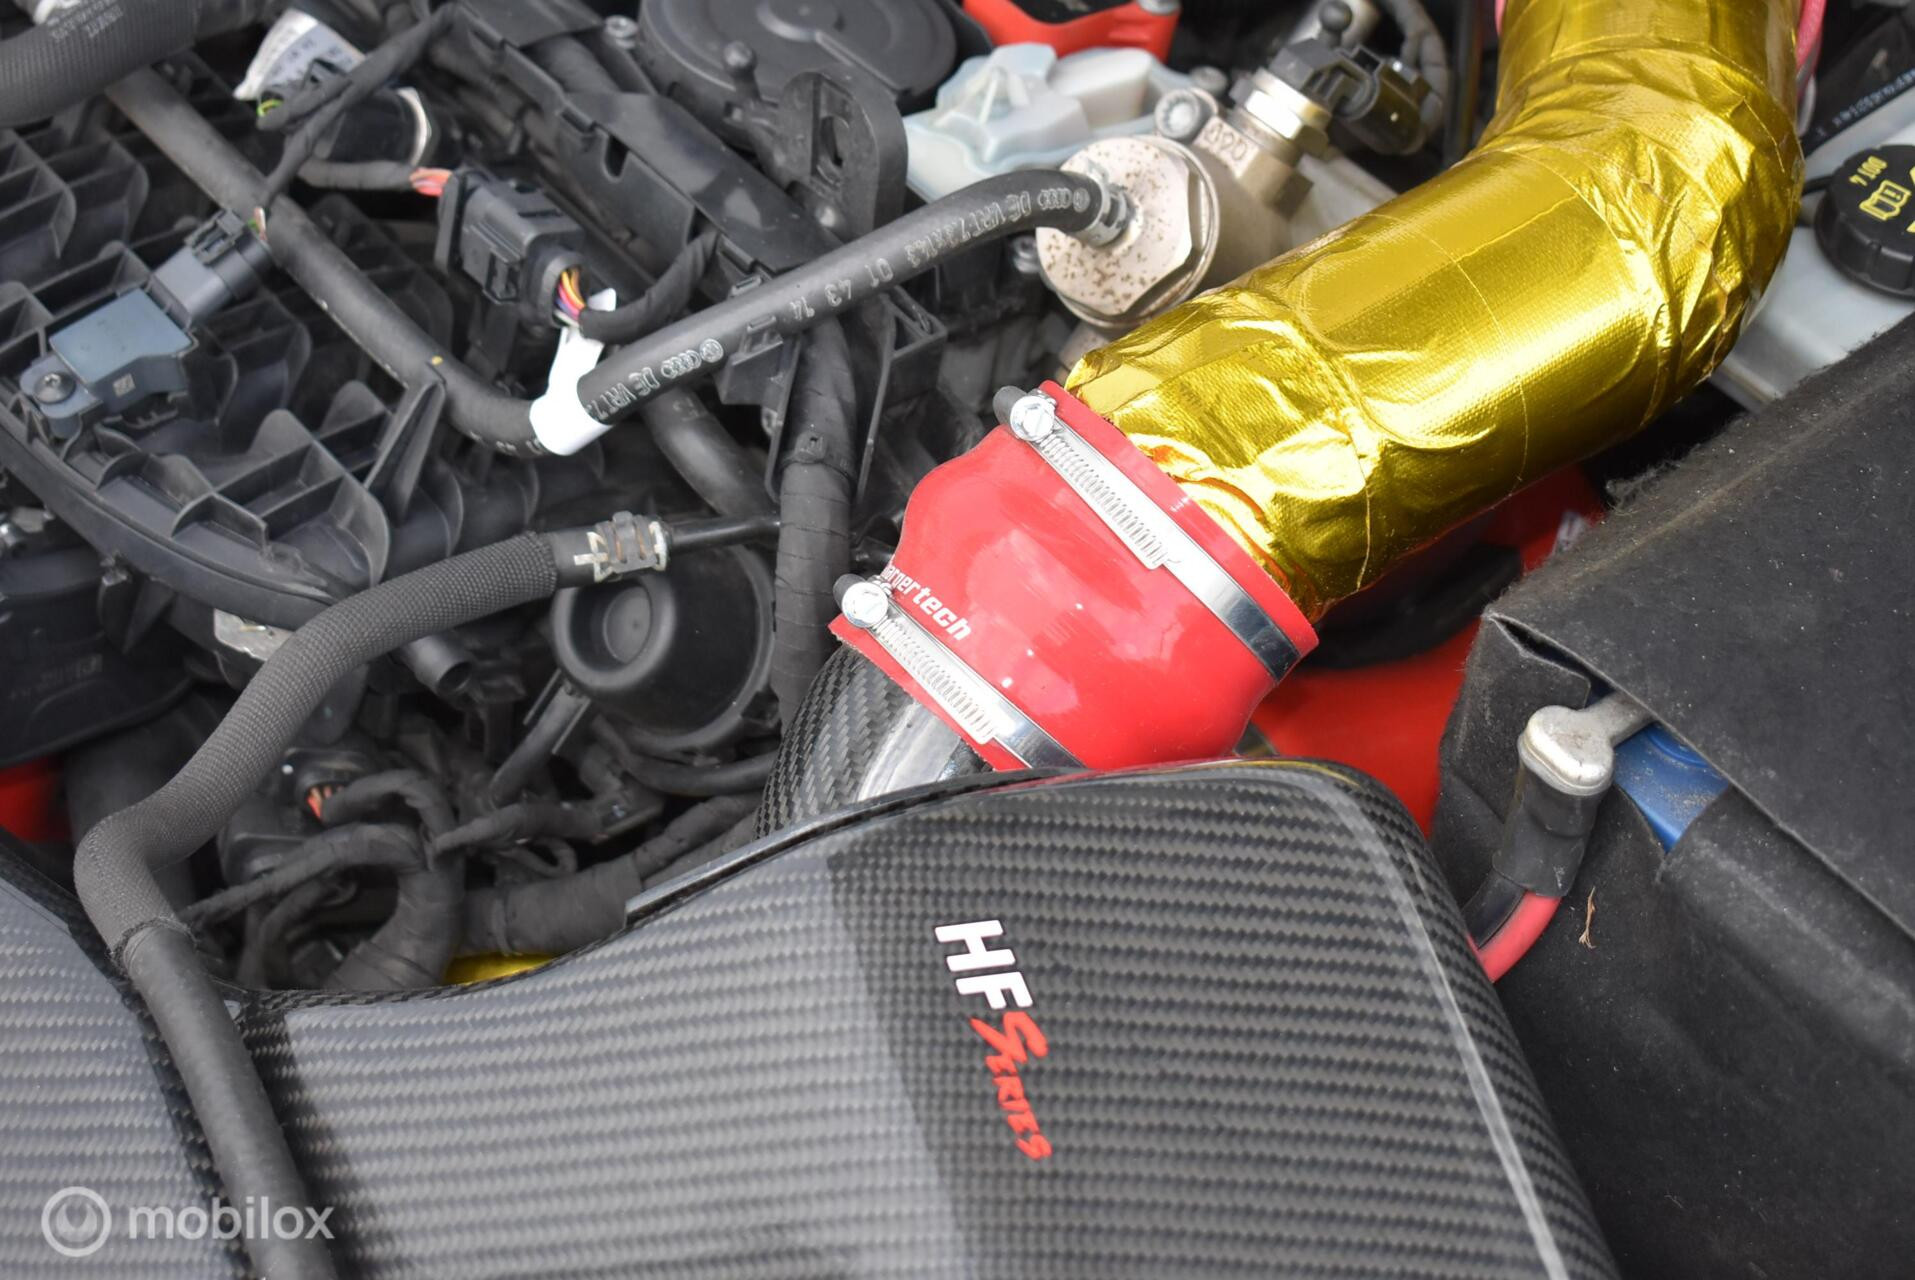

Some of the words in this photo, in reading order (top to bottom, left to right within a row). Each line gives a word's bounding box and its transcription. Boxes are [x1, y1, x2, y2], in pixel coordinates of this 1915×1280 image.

[1006, 191, 1032, 222] DE
[864, 258, 894, 289] 01
[824, 279, 852, 307] 43
[628, 367, 661, 396] DE
[935, 919, 1034, 1010] HF
